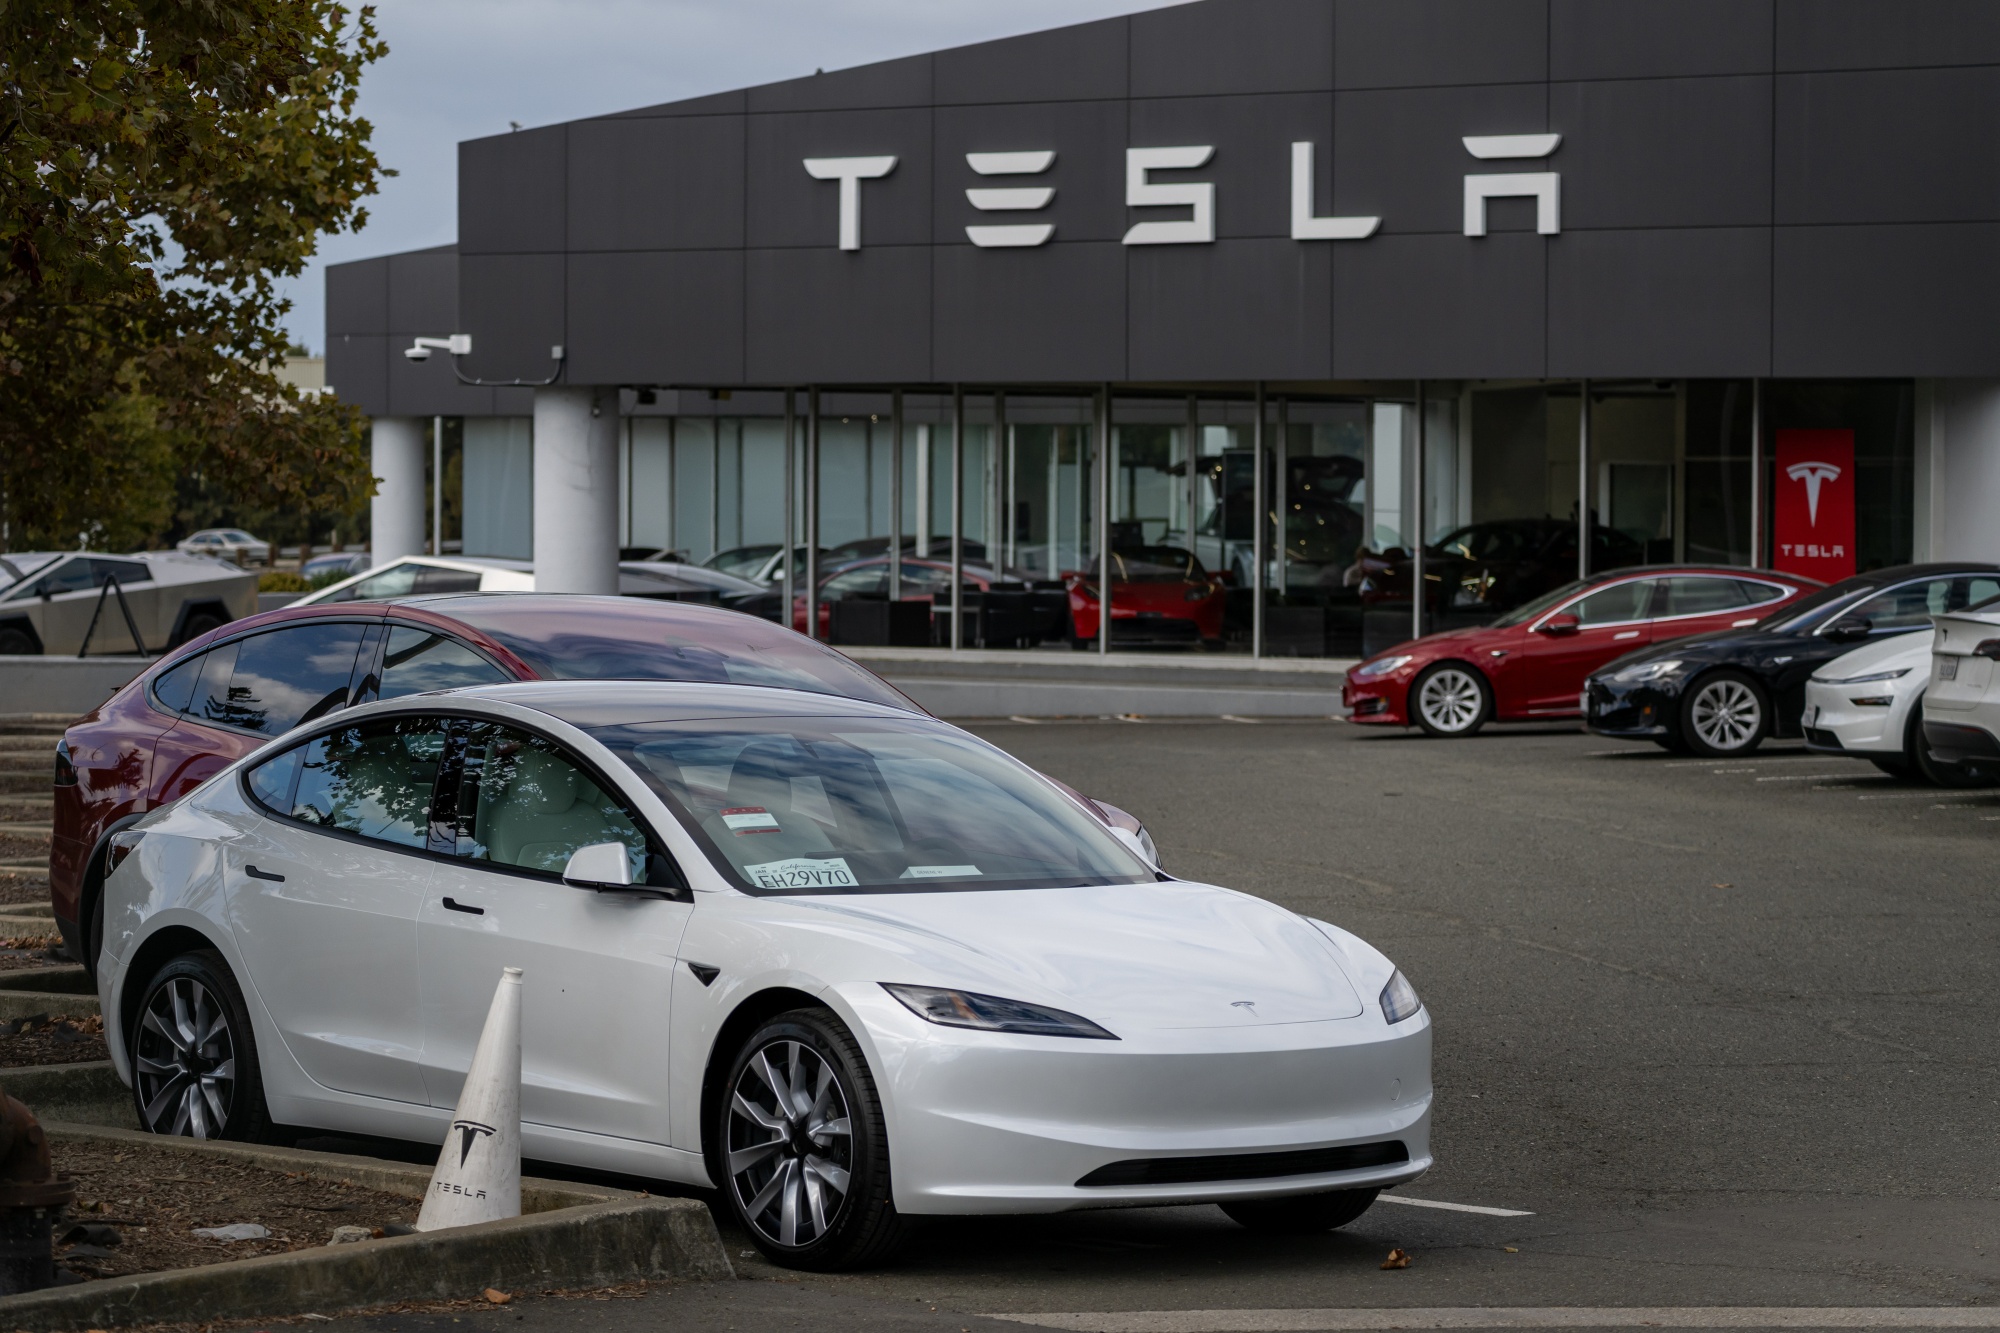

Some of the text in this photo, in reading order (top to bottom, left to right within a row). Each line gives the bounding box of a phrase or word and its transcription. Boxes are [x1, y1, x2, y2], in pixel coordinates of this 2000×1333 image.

[803, 133, 1562, 251] TESLA
[1781, 544, 1844, 558] TESLA
[757, 869, 851, 888] EH29V70
[436, 1181, 487, 1200] TESLA
